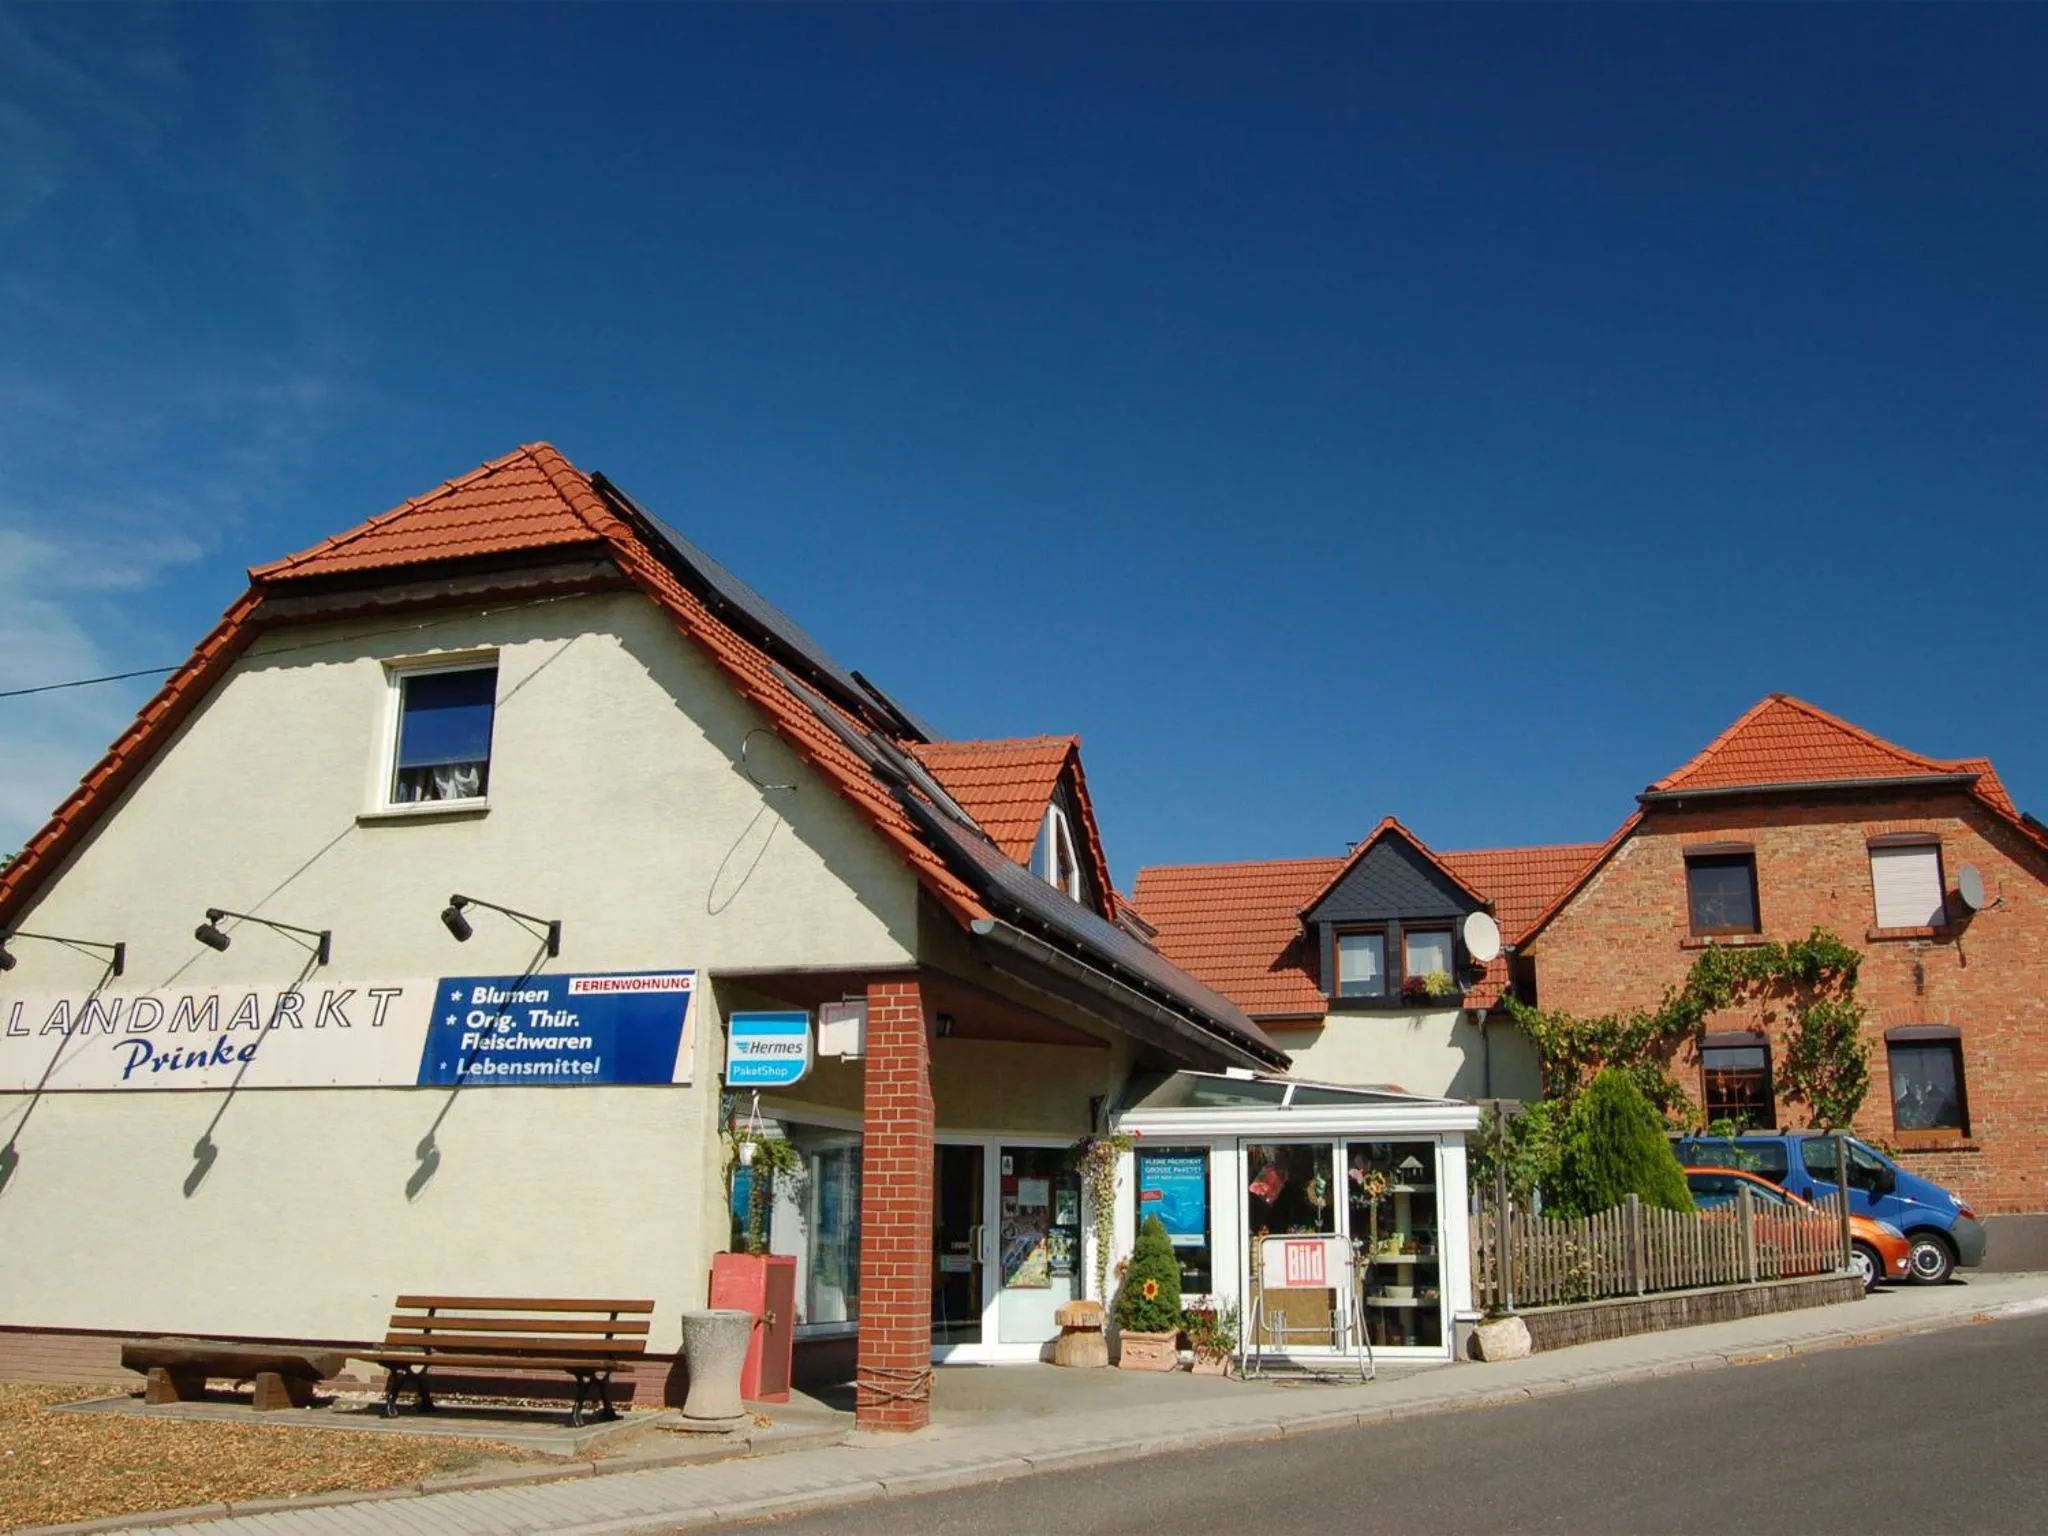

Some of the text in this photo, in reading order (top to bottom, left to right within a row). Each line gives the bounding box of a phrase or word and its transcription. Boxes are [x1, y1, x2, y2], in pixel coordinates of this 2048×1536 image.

[574, 977, 691, 992] FERIENWOHNUNG
[471, 986, 549, 1004] Blumen
[6, 988, 402, 1037] LANDMARKT
[466, 1009, 580, 1033] Orig. Thür.
[460, 1032, 593, 1051] Fleischwaren
[750, 1041, 803, 1055] Hermes
[112, 1034, 258, 1080] Prinke
[456, 1056, 602, 1076] Lebensmittel
[733, 1065, 789, 1078] PaketShop
